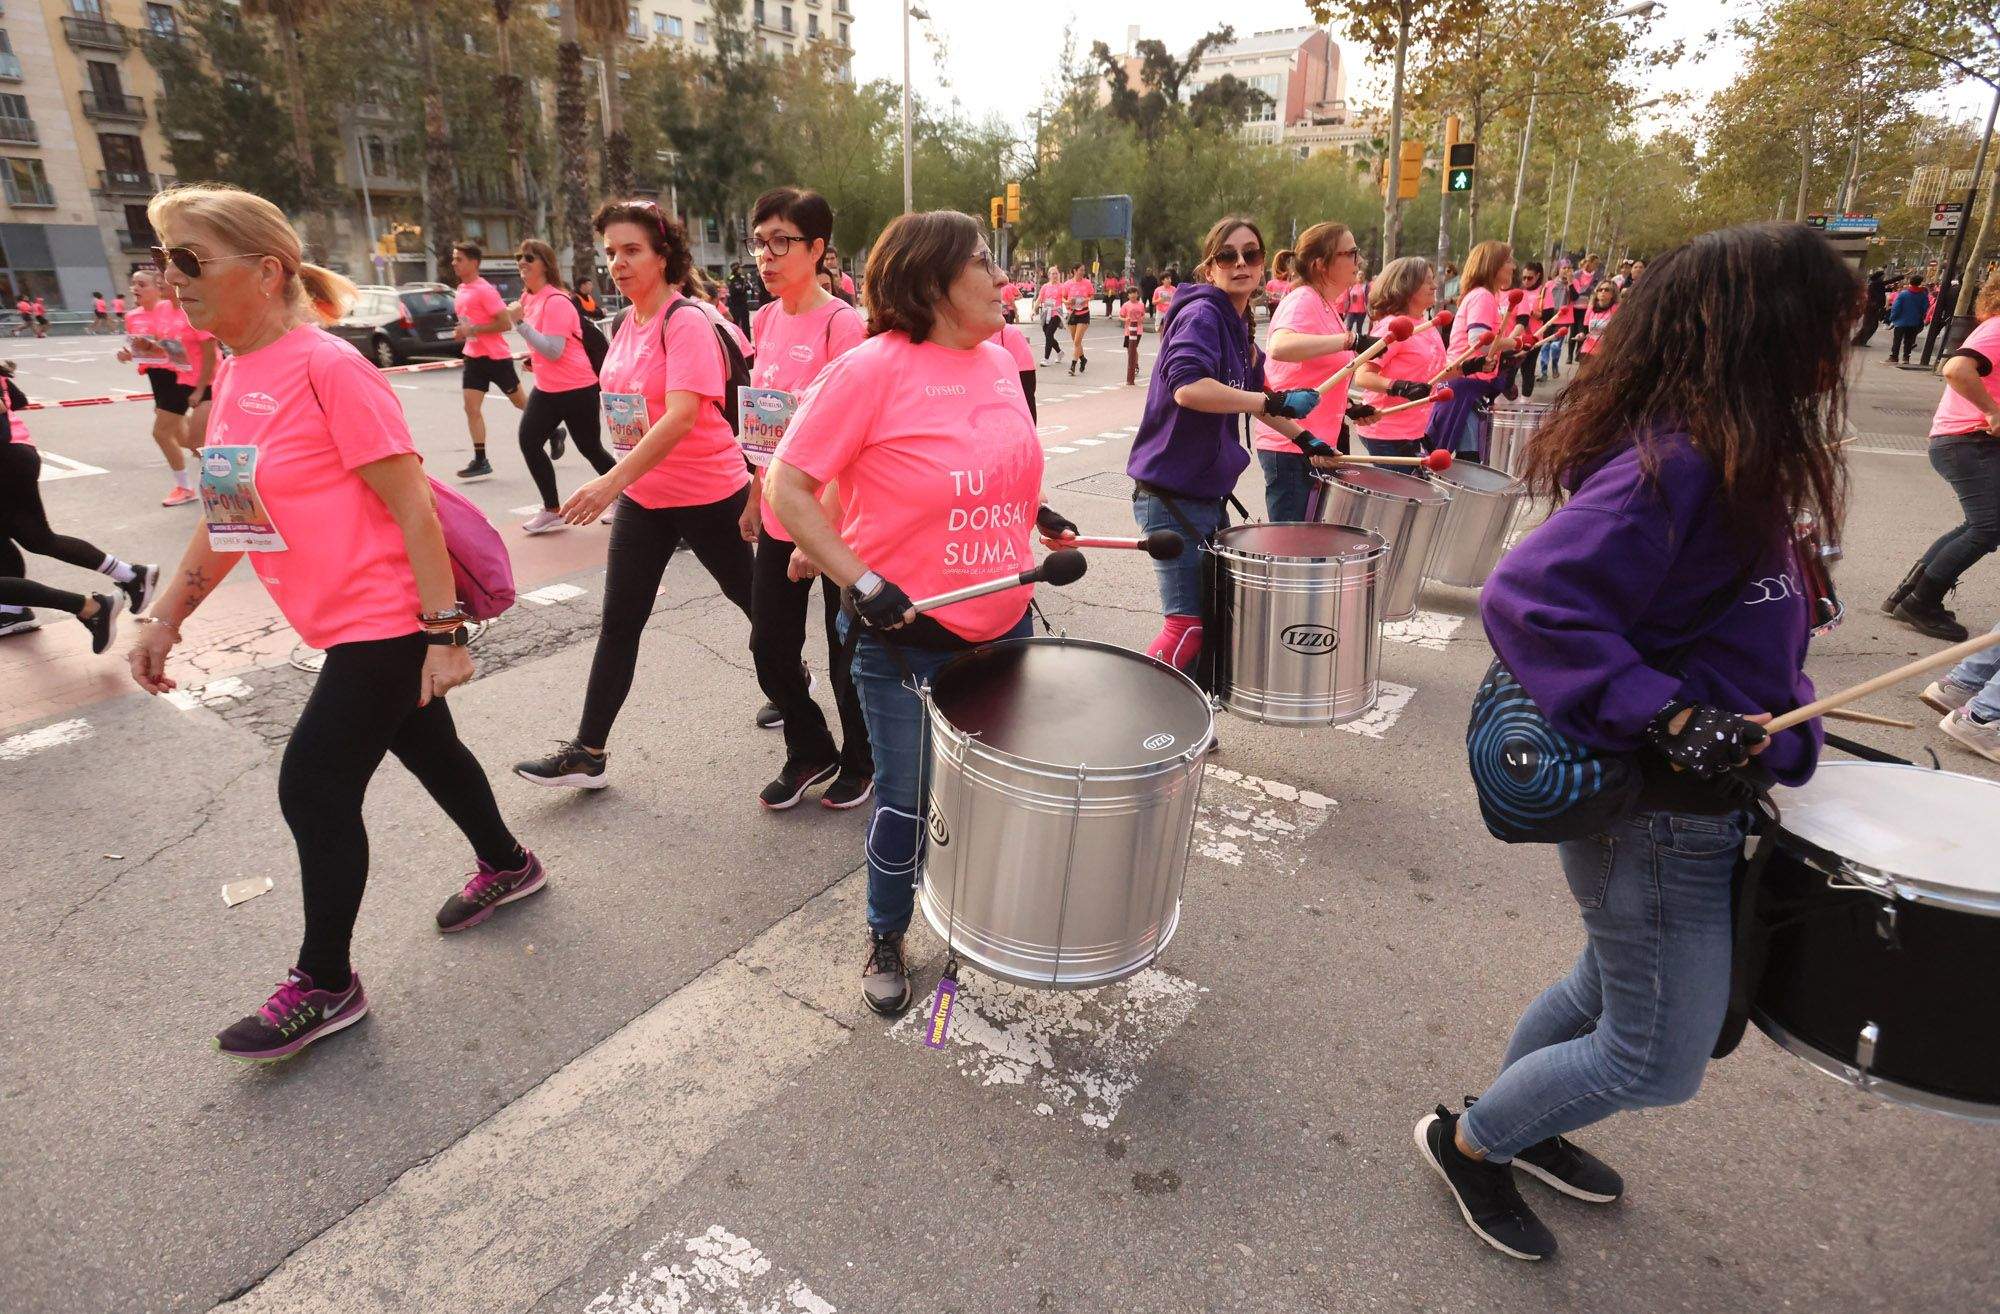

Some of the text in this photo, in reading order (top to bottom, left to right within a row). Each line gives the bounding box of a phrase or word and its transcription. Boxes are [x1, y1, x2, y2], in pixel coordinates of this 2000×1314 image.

[949, 470, 984, 497] TU
[943, 537, 1017, 567] SUMA
[1287, 631, 1335, 647] IZZO
